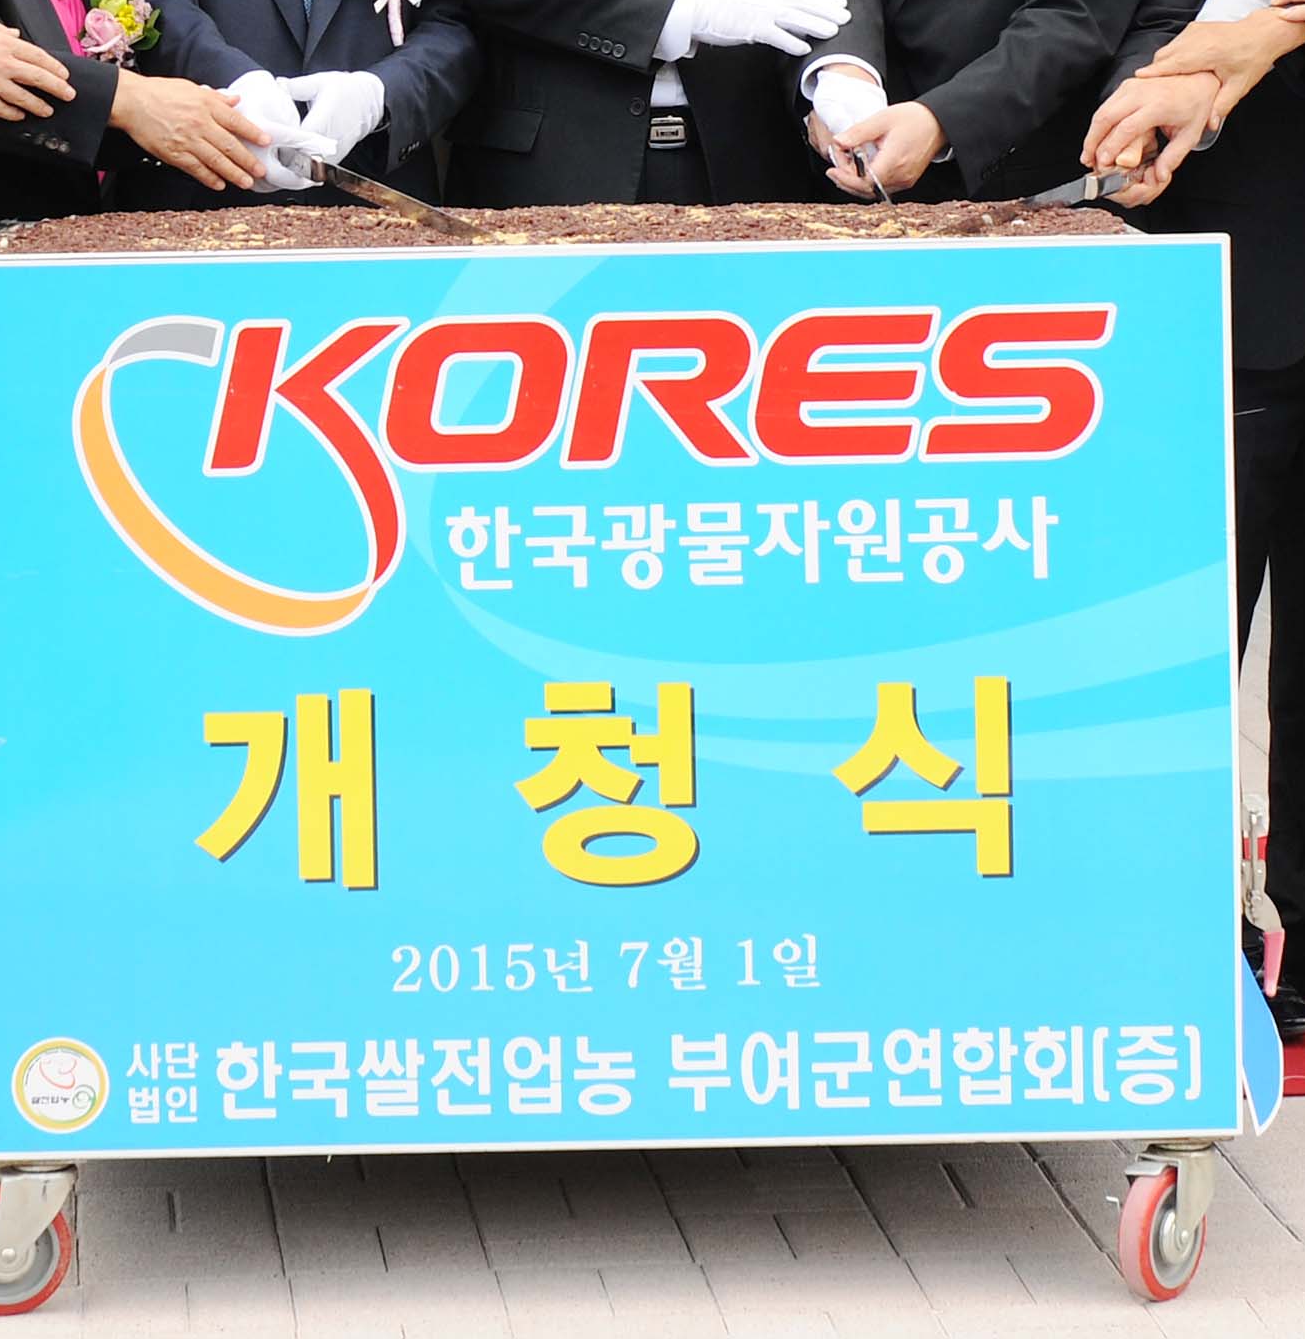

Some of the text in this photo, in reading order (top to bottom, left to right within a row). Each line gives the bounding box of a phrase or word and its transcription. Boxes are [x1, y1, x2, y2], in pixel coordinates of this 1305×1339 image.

[204, 303, 1117, 581] KORES
[444, 495, 1060, 593] 한국광물자원공사
[390, 933, 822, 994] 2015년 7월 1일
[125, 1042, 199, 1081] 사단
[215, 1035, 636, 1120] 한국쌀전업농
[127, 1086, 199, 1124] 법인
